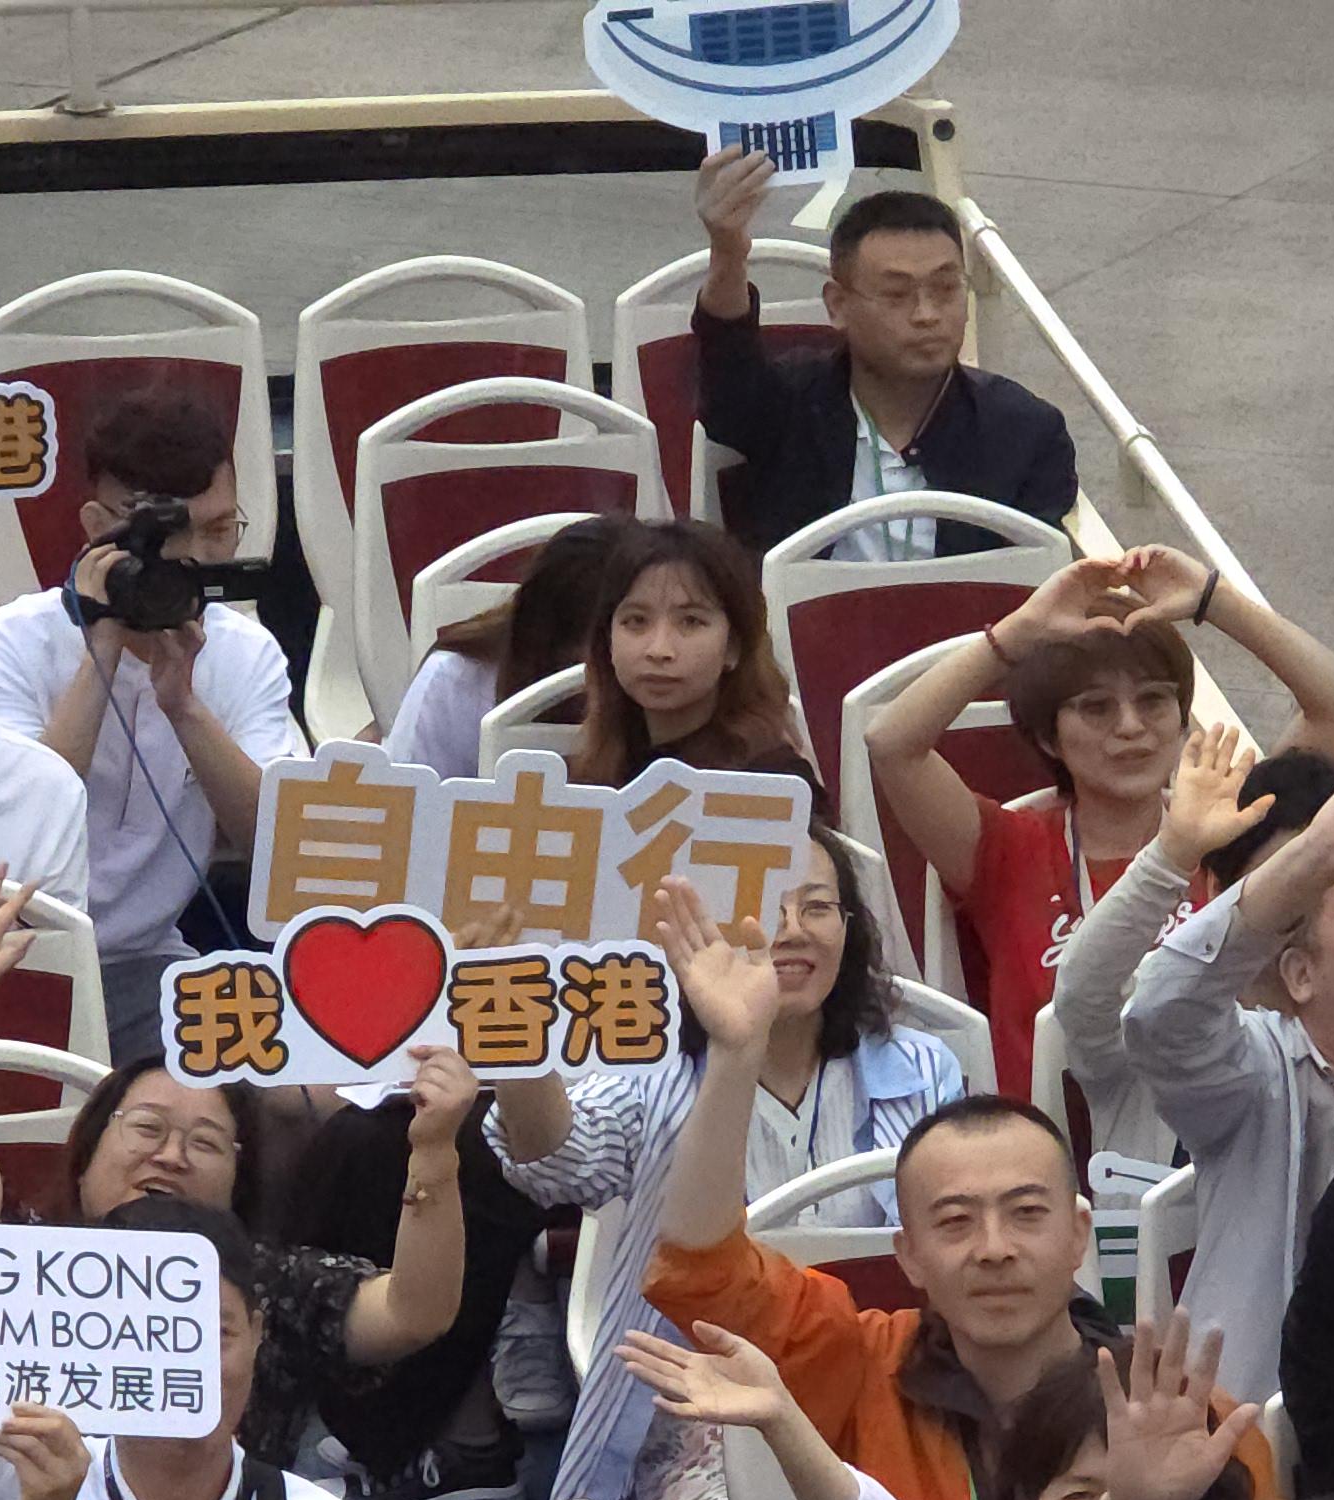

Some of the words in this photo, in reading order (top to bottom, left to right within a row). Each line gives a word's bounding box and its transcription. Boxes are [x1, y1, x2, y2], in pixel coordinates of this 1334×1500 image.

[269, 762, 794, 949] 自由行
[173, 950, 289, 1078] 我
[447, 950, 670, 1067] 香港
[36, 1250, 202, 1303] KONG
[52, 1310, 202, 1353] BOARD
